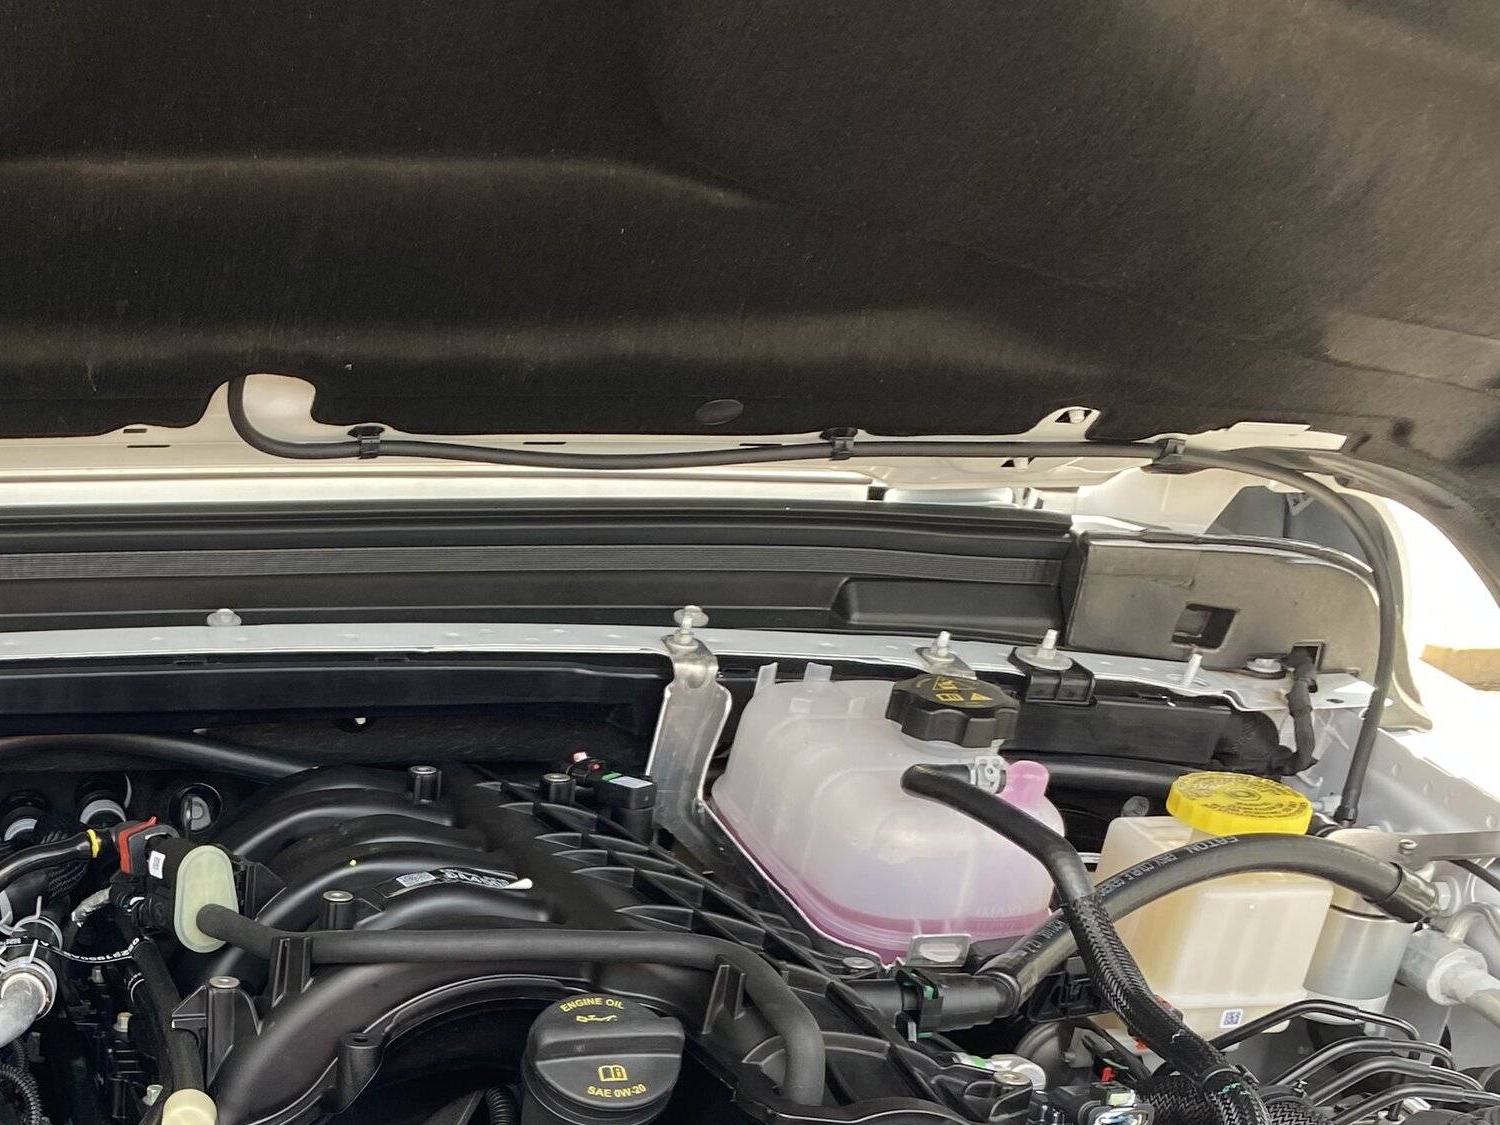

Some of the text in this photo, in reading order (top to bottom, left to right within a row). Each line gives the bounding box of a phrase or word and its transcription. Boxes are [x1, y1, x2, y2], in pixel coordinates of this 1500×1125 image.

[560, 998, 624, 1012] ENGINE OIL
[587, 1084, 646, 1097] SAE 0W-20
